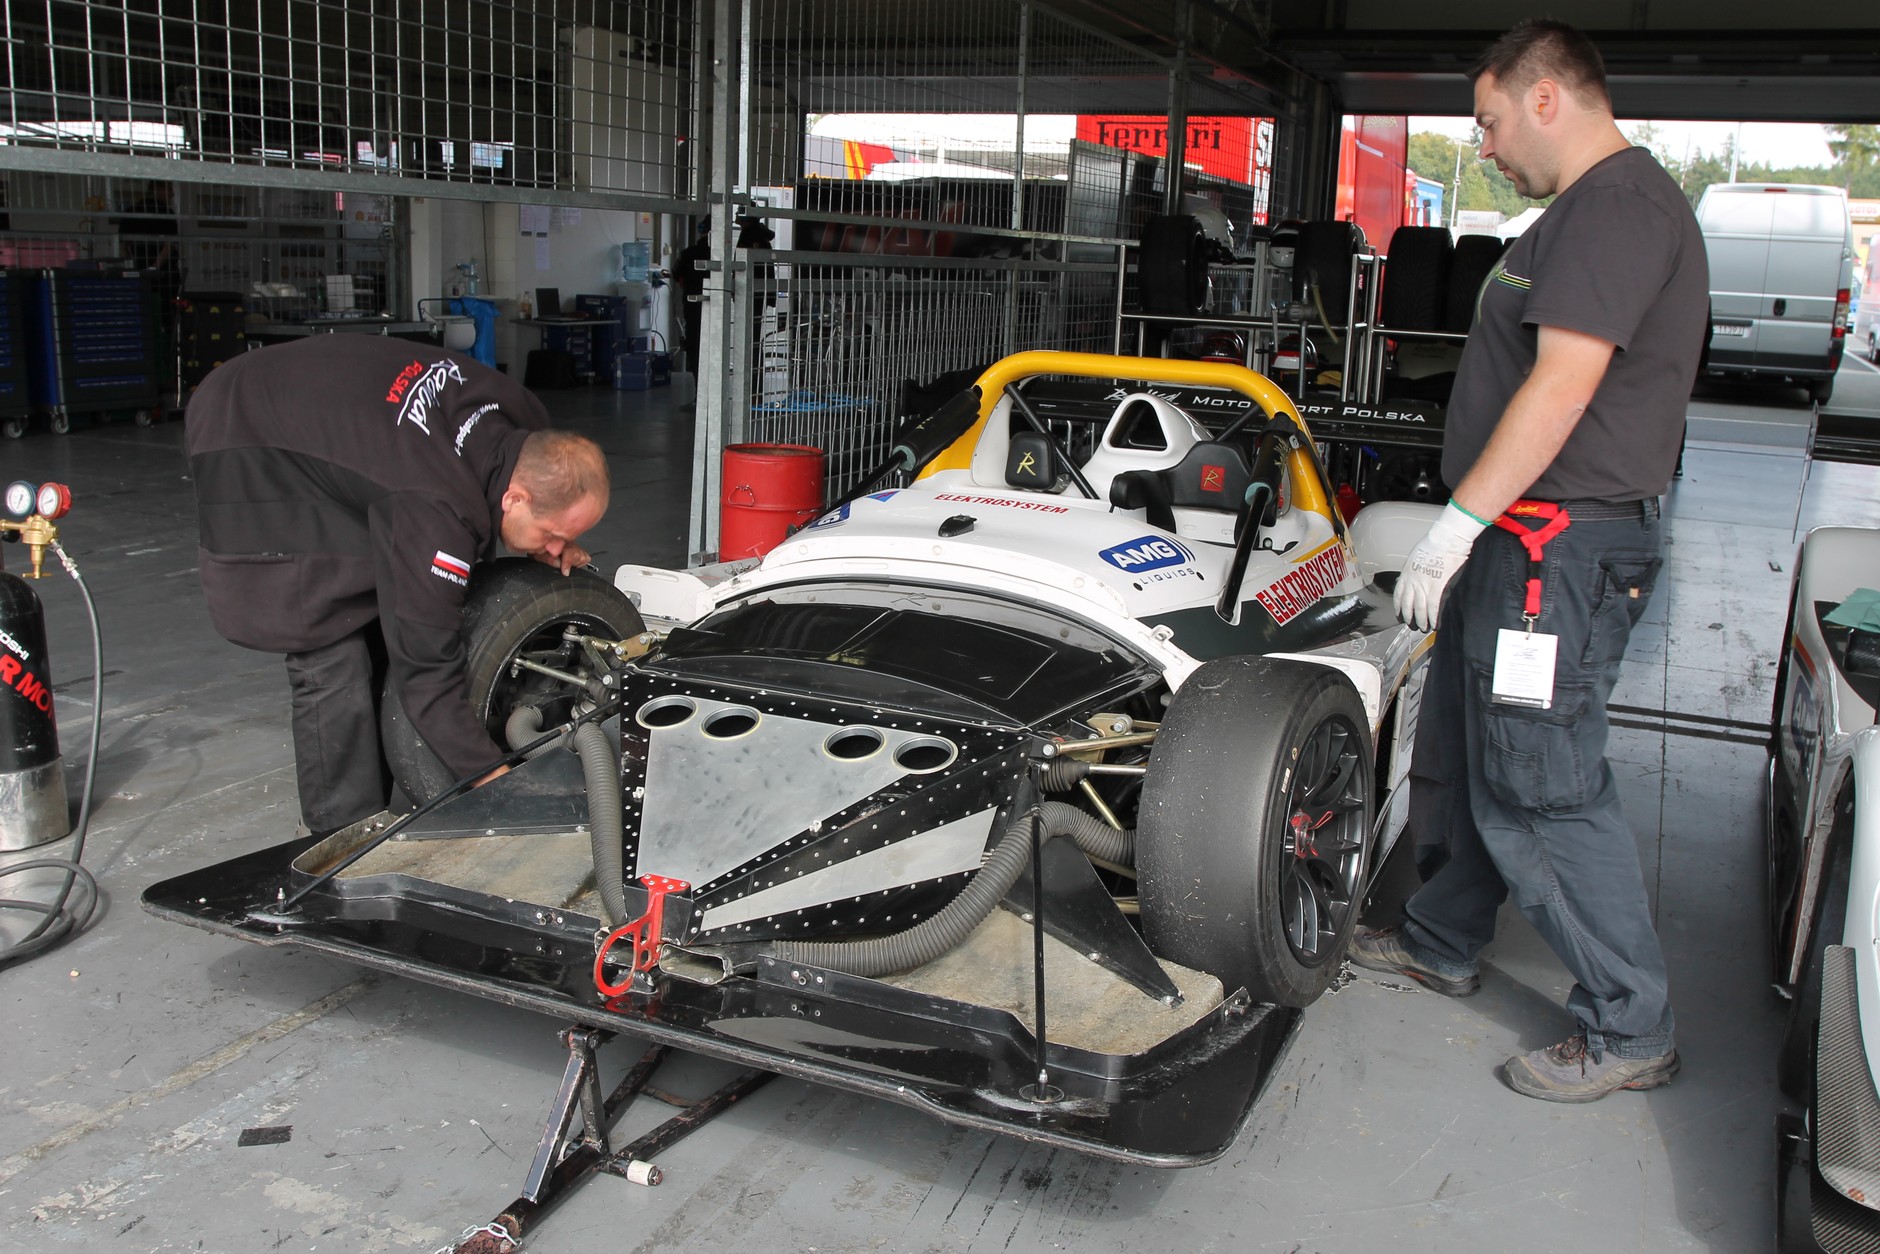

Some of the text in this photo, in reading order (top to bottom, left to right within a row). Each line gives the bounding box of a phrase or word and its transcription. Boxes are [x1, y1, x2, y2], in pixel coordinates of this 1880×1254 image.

[1097, 121, 1221, 149] Ferrri
[386, 359, 423, 404] POLSKA
[1342, 406, 1427, 423] POLSKA
[933, 493, 1070, 514] ELEKTROSYSTEM
[1111, 541, 1178, 568] AMG
[1139, 567, 1195, 585] LIQUIDS
[1254, 543, 1350, 625] ELEKTROSYSTEM
[15, 671, 54, 720] MO
